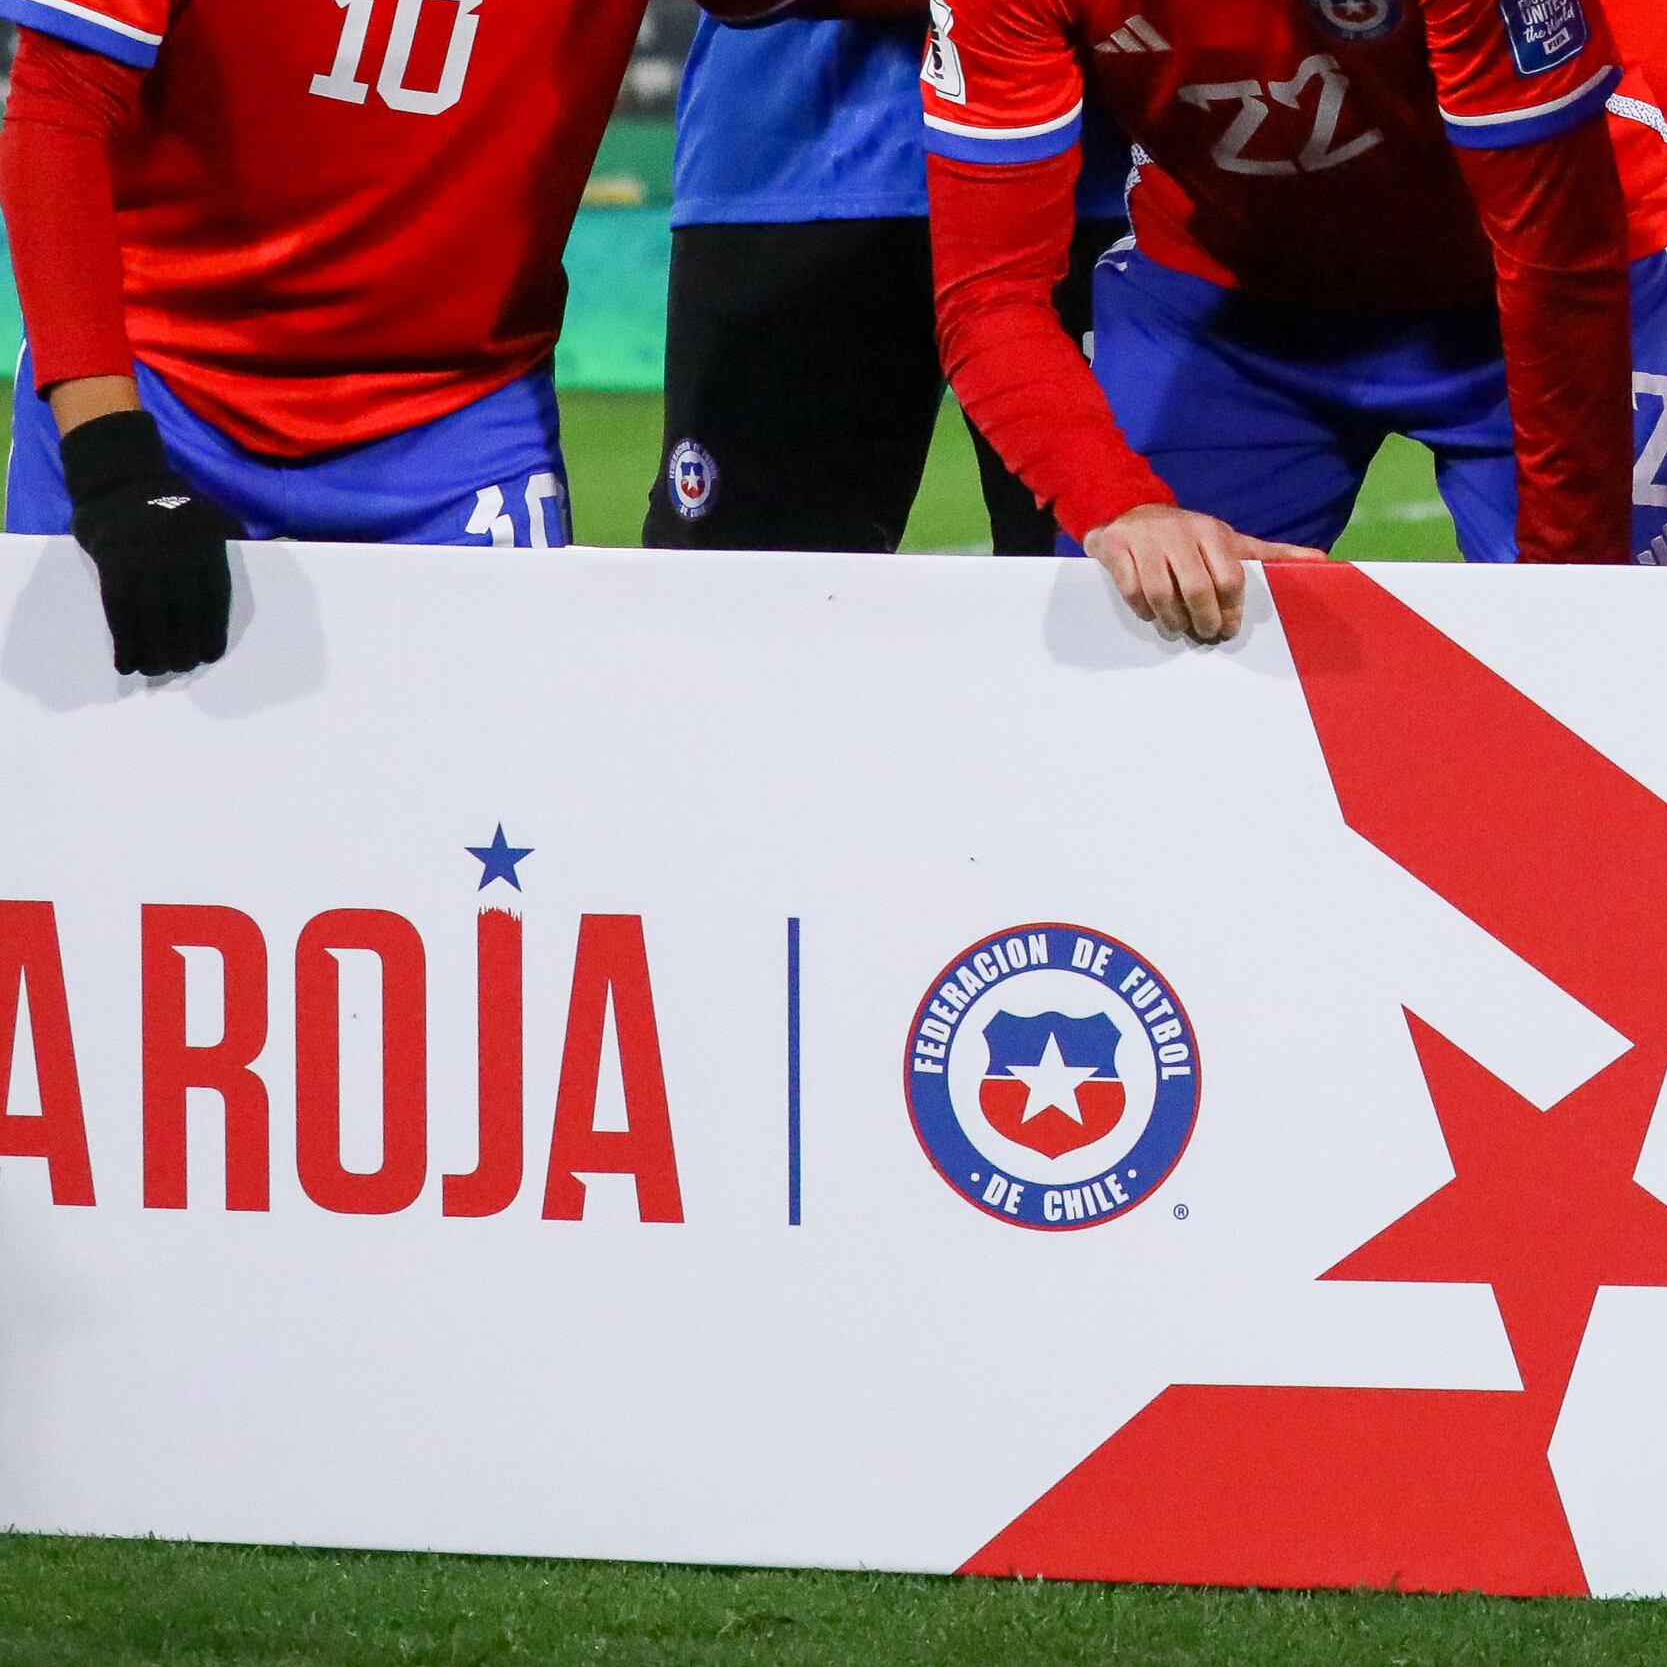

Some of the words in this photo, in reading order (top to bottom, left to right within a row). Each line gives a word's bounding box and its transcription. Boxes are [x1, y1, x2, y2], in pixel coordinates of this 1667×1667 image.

[1523, 25, 1546, 44] the
[1178, 54, 1385, 177] 22
[141, 904, 685, 1225] ROJA
[913, 933, 1049, 1074] FEDERACION
[1071, 936, 1113, 977] DE
[1118, 966, 1192, 1081] FUTBOL
[982, 1173, 1025, 1215] DE
[1043, 1173, 1130, 1222] CHILE
